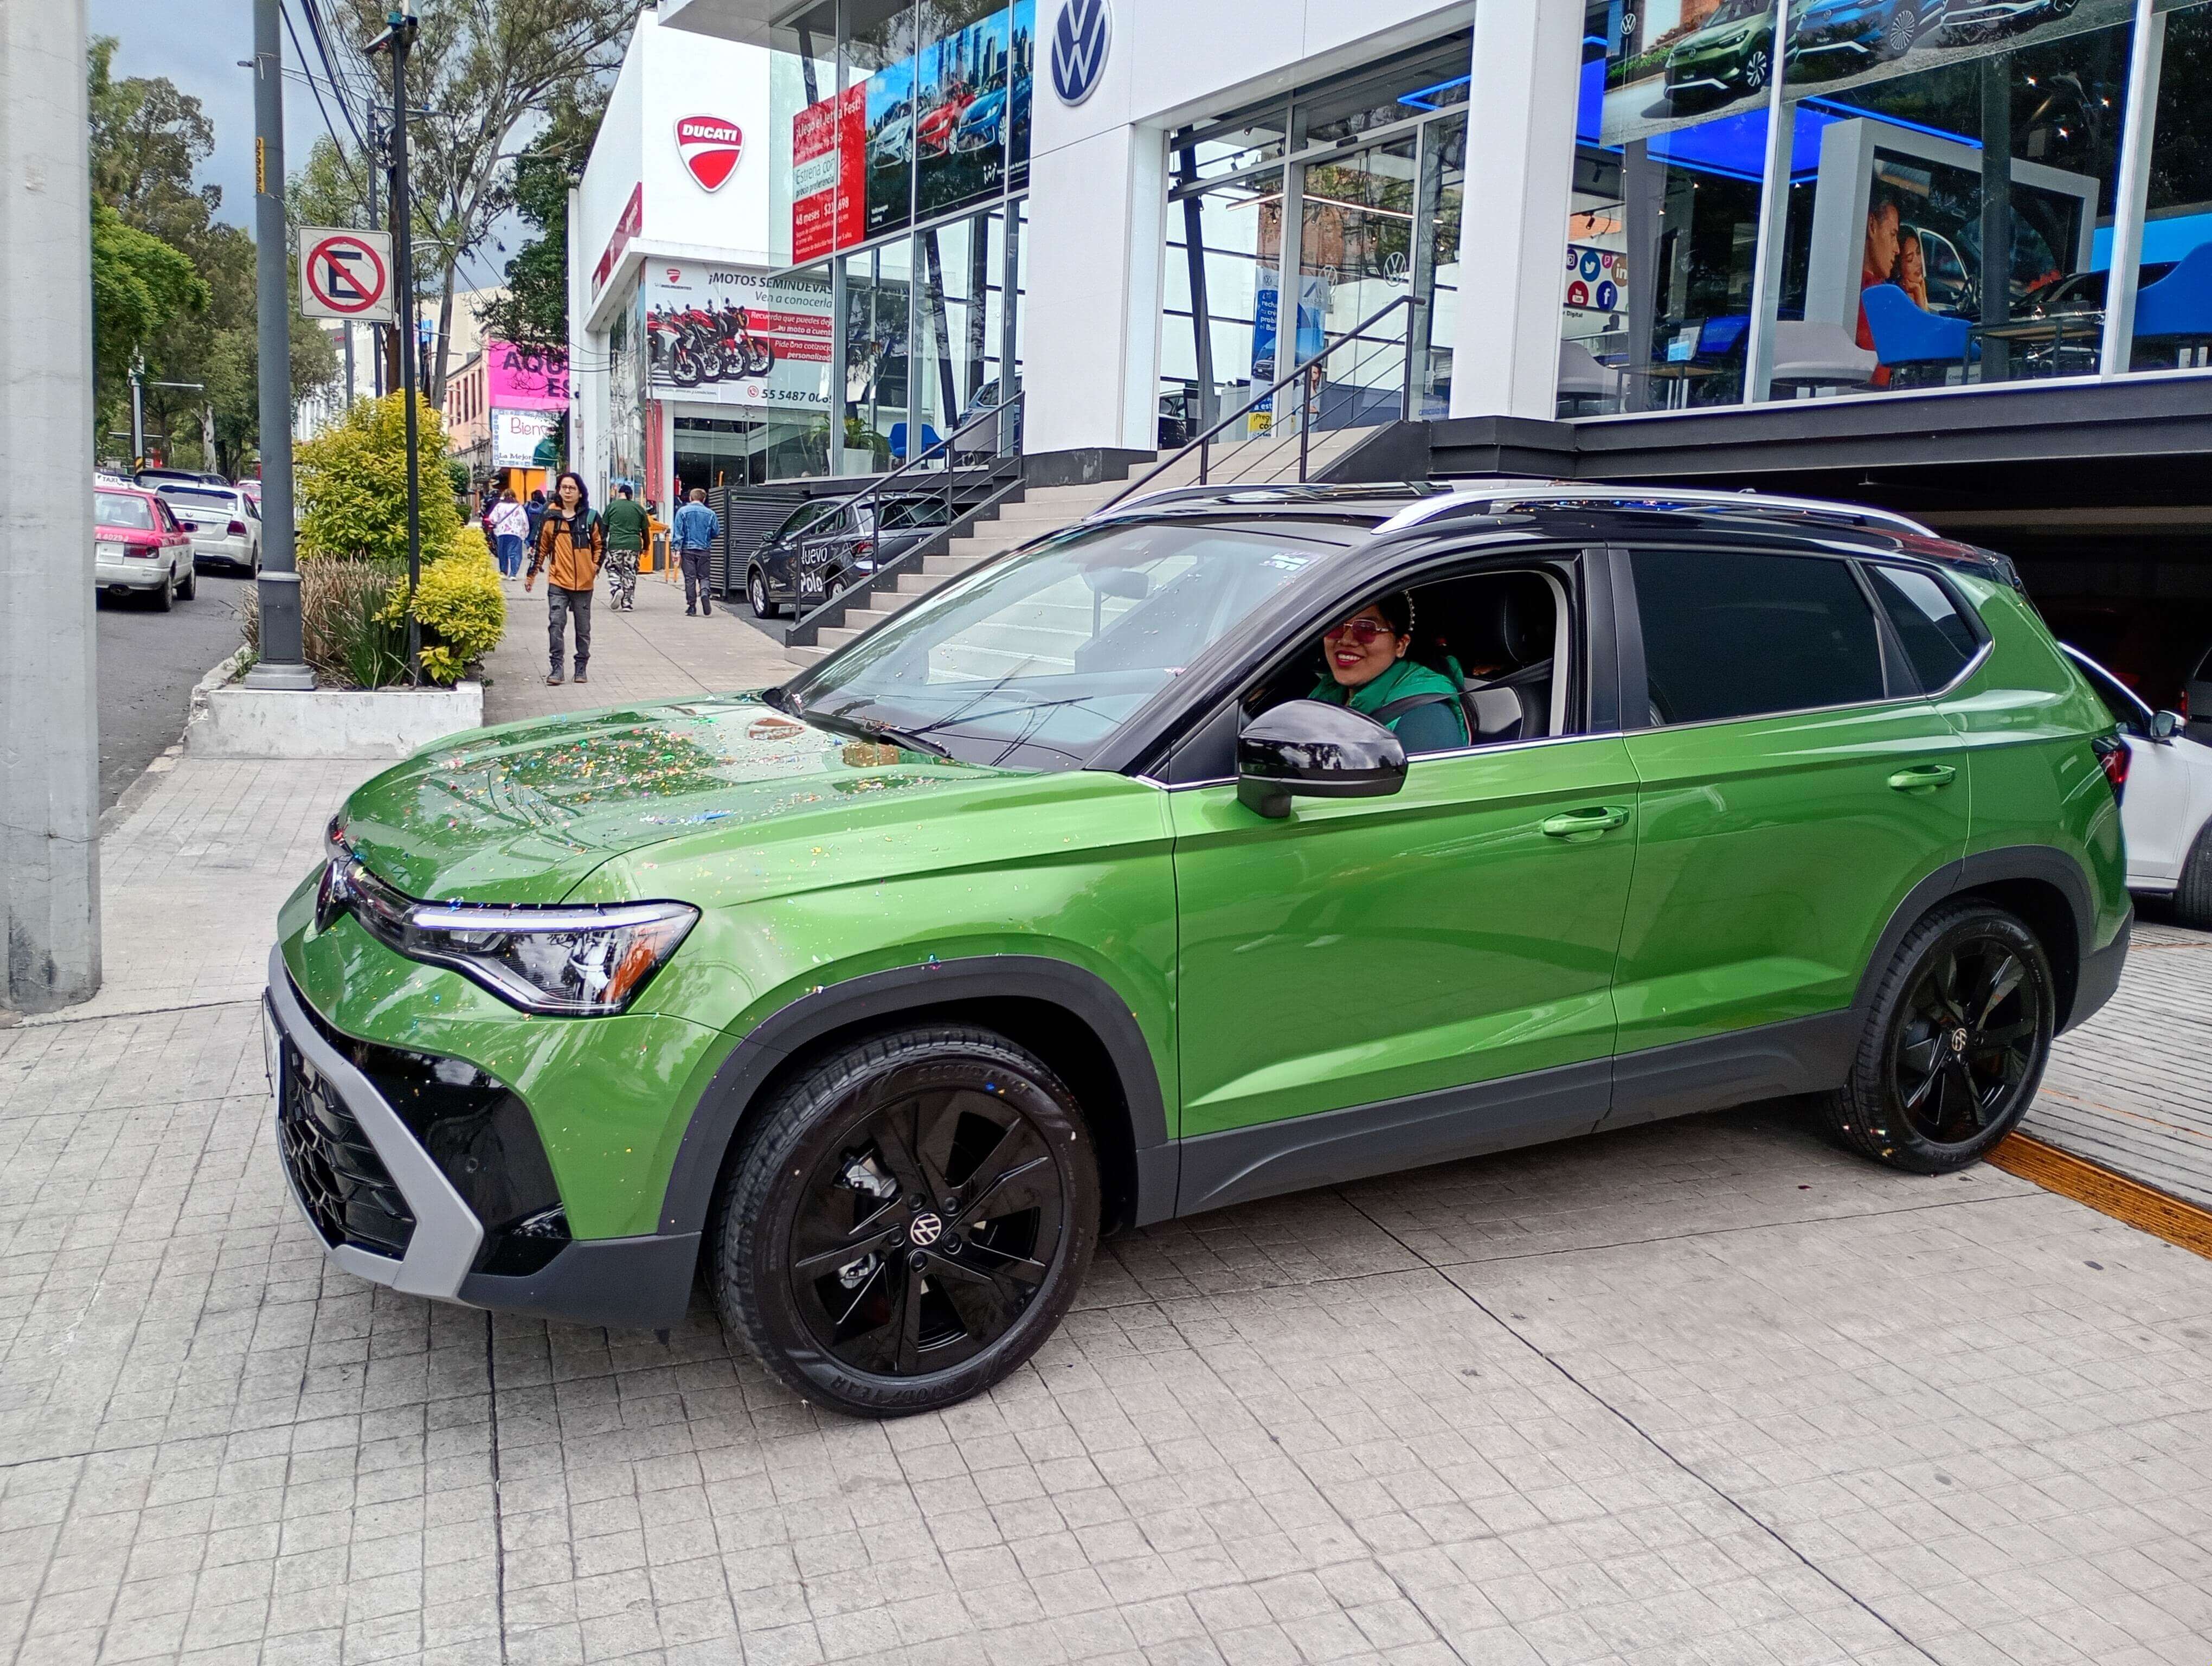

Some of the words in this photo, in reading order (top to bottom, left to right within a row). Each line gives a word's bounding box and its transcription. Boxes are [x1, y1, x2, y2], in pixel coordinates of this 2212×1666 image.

[823, 109, 843, 125] Jeta
[683, 124, 737, 142] DUCATI
[796, 164, 821, 184] Estrena
[709, 273, 756, 286] ¡MOTOS
[756, 291, 773, 302] Ven
[751, 311, 782, 321] Recuerda
[796, 316, 819, 325] puedes
[761, 389, 775, 399] 55
[778, 390, 806, 401] 5487
[1253, 414, 1271, 423] ¡Preg
[801, 572, 823, 592] Polo
